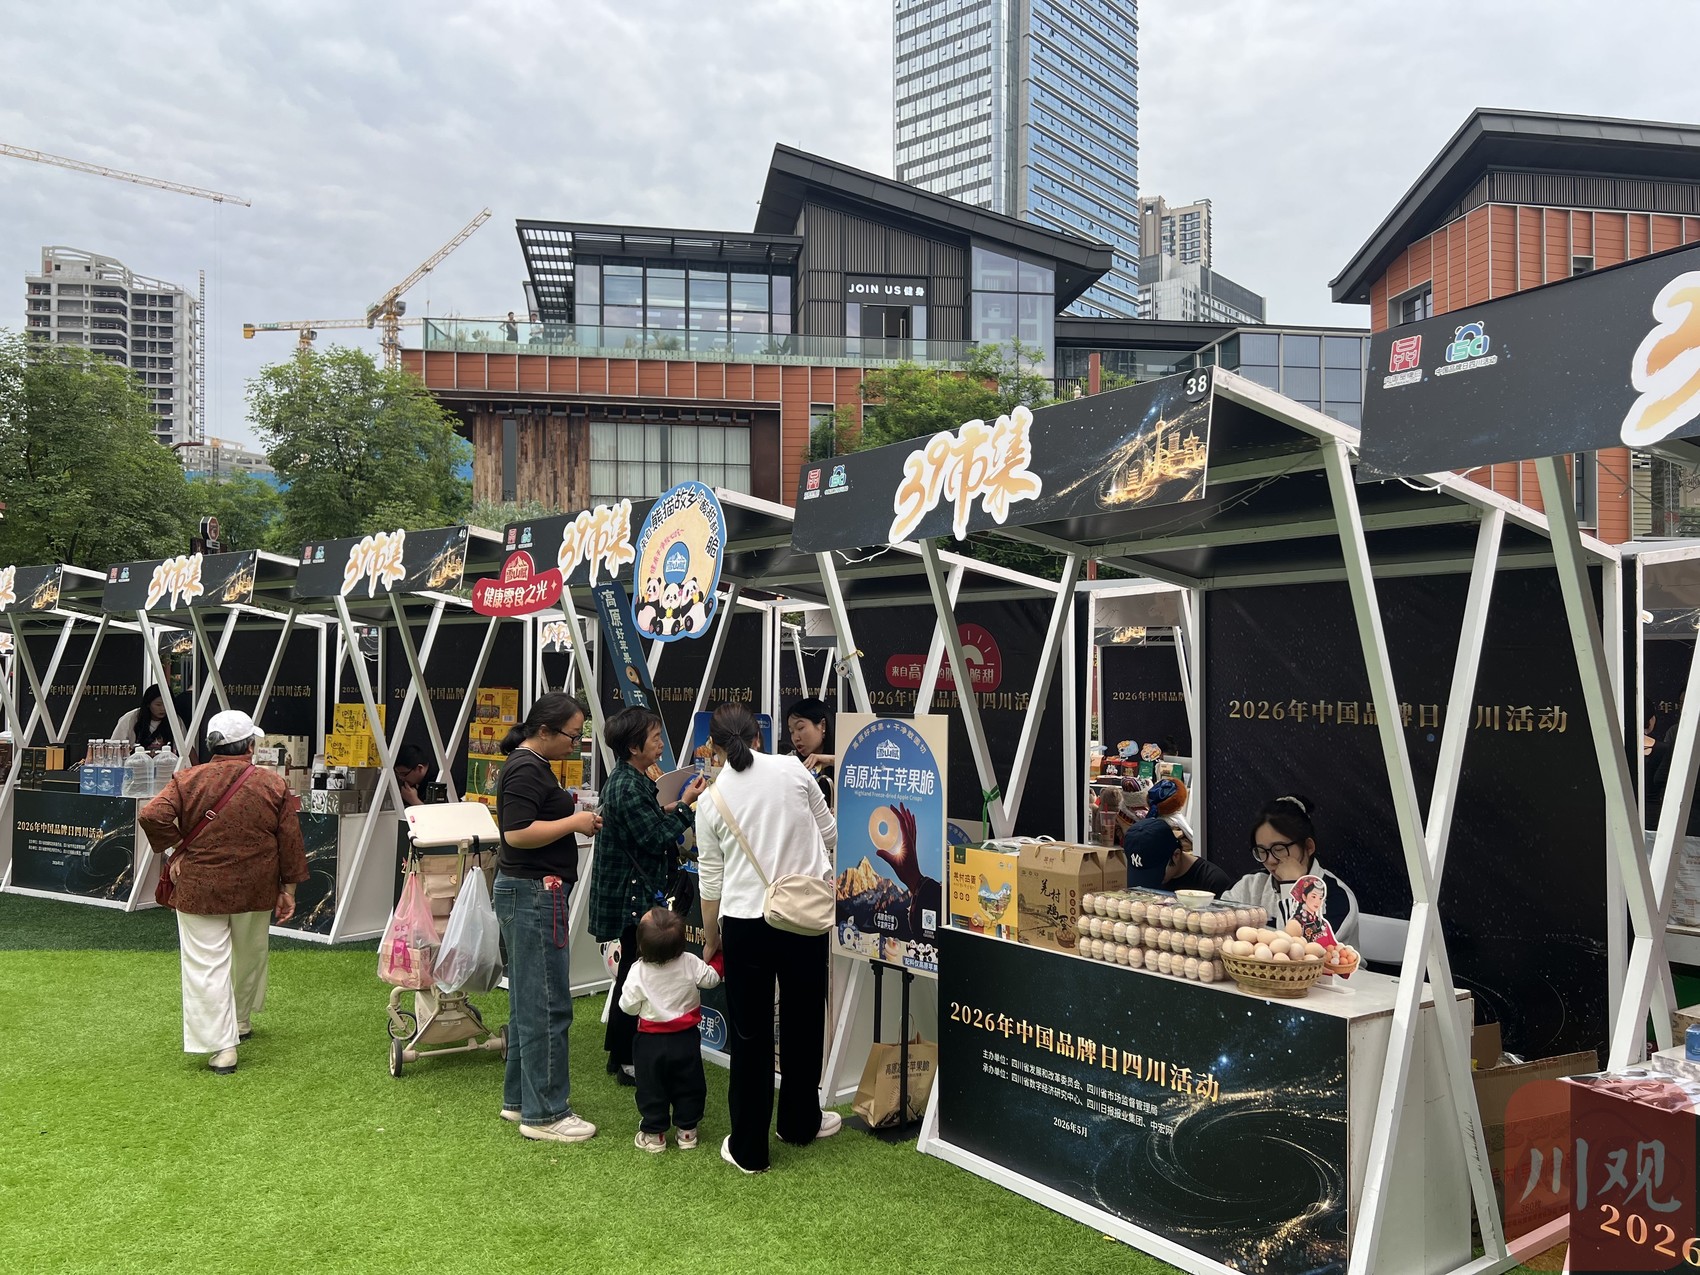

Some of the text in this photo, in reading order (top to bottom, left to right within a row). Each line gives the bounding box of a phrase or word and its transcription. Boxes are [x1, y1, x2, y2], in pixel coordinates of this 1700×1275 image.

[848, 284, 879, 294] JOIN
[884, 285, 902, 295] US
[1186, 374, 1207, 395] 38
[483, 580, 548, 608] 健康零食之光
[1228, 700, 1568, 734] 2026年中国品牌日川活动
[844, 764, 935, 796] 高原冻干苹果脆
[17, 821, 104, 839] 2026年中国品牌日四川活动
[1131, 853, 1143, 868] NY
[949, 1001, 1220, 1103] 2026年中国品牌日四川活动
[885, 1060, 930, 1076] 高原苹果脆
[1053, 1116, 1088, 1138] 2026年5月
